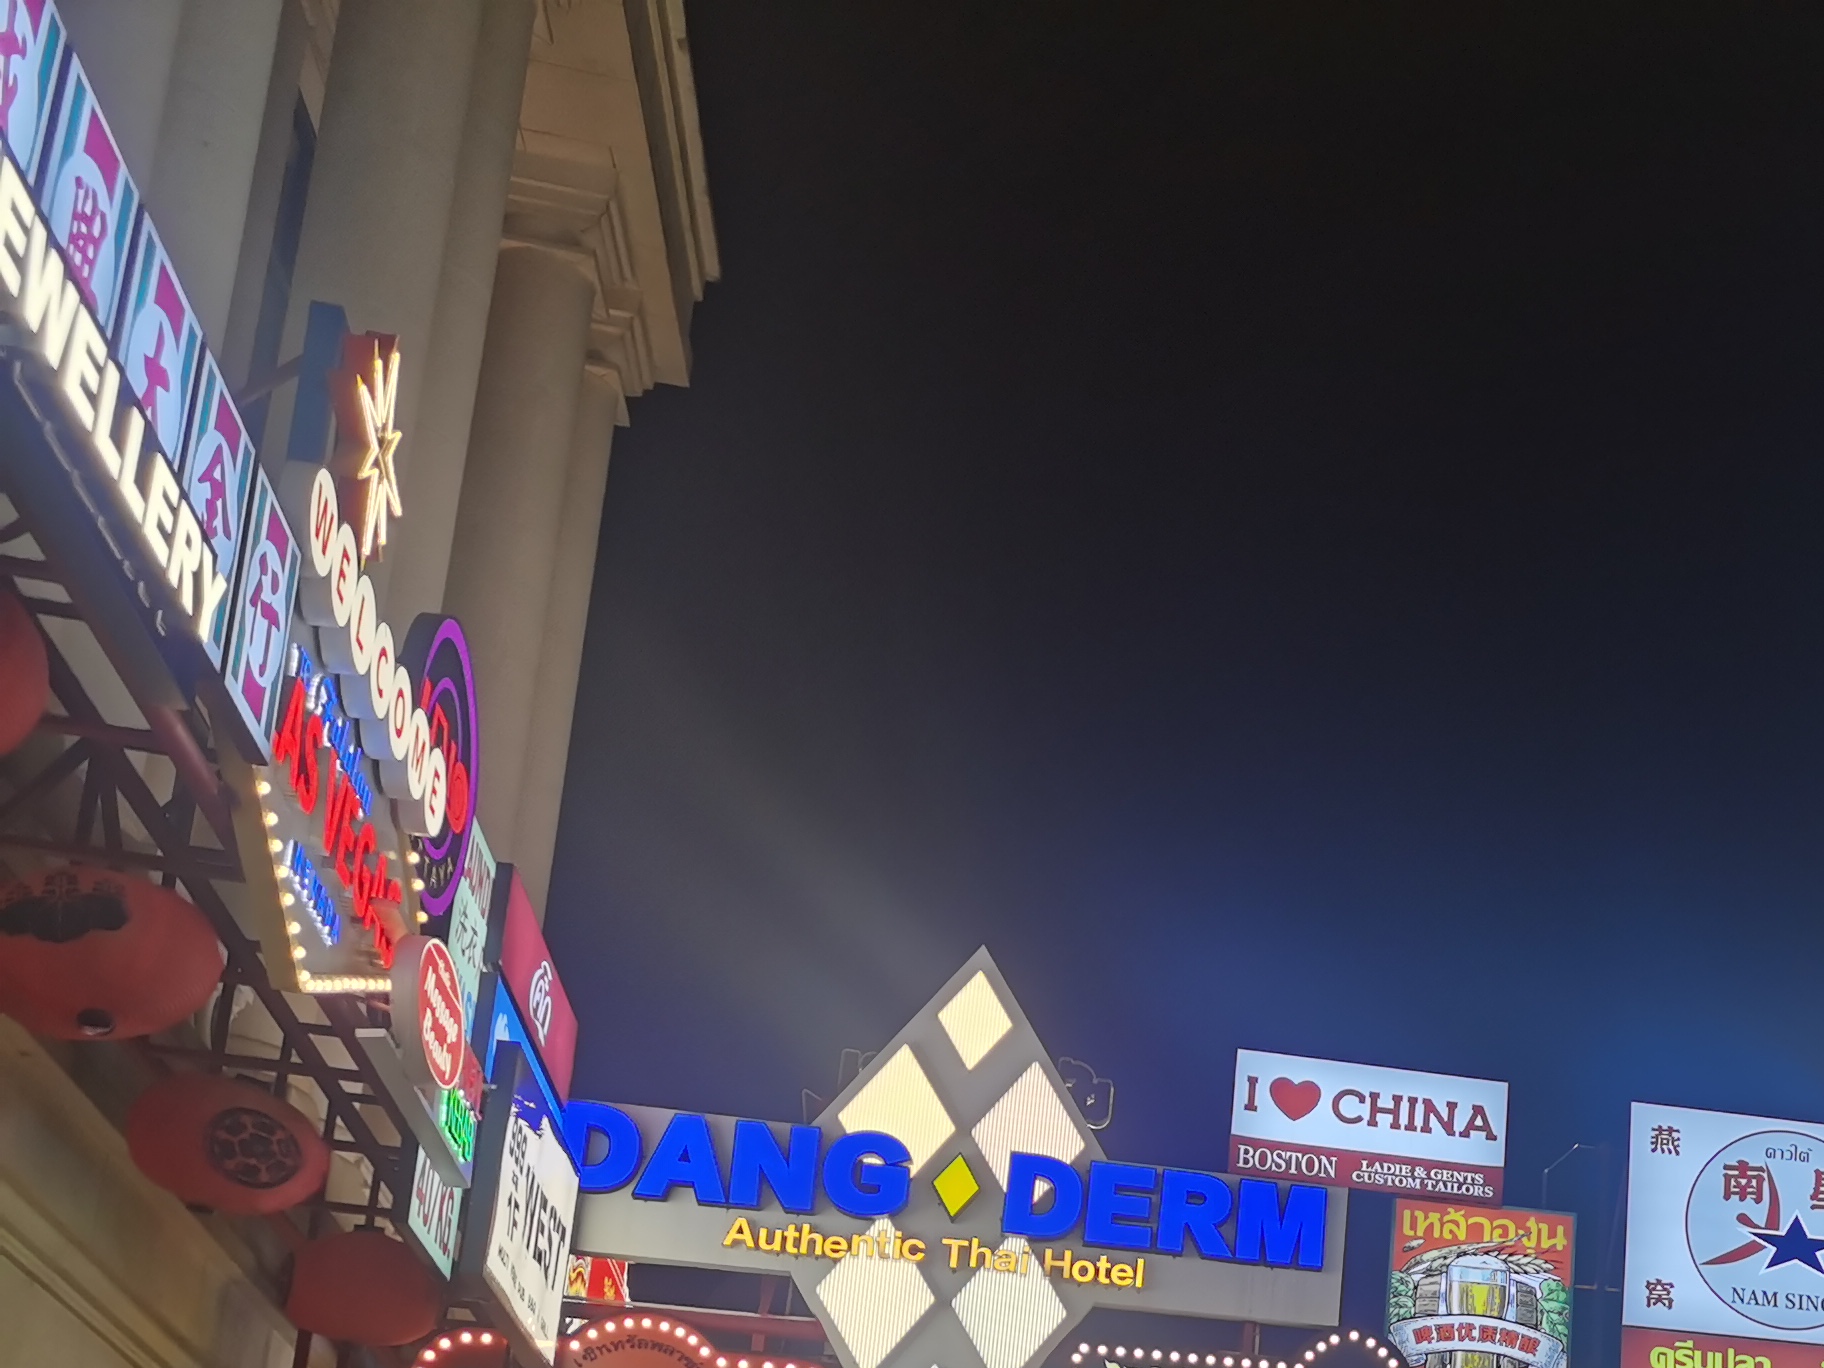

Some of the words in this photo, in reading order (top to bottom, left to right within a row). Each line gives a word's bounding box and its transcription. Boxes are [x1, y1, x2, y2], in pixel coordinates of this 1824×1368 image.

[0, 140, 229, 645] EWELLERY
[315, 480, 441, 817] WELCOME
[1243, 1075, 1259, 1112] I
[1331, 1088, 1498, 1141] CHINA
[563, 1100, 911, 1219] DANG
[1001, 1151, 1328, 1272] DERM
[1236, 1144, 1338, 1179] BOSTON
[1351, 1169, 1420, 1190] CUSTOM
[1424, 1178, 1494, 1198] TAILORS
[1361, 1159, 1410, 1176] LADIE
[1414, 1165, 1427, 1177] &
[1430, 1168, 1485, 1185] GENTS
[522, 1161, 567, 1292] WEST
[723, 1216, 926, 1262] Authentic
[942, 1237, 1031, 1275] Thai
[1045, 1249, 1146, 1290] Hotel
[1731, 1287, 1779, 1309] NAM
